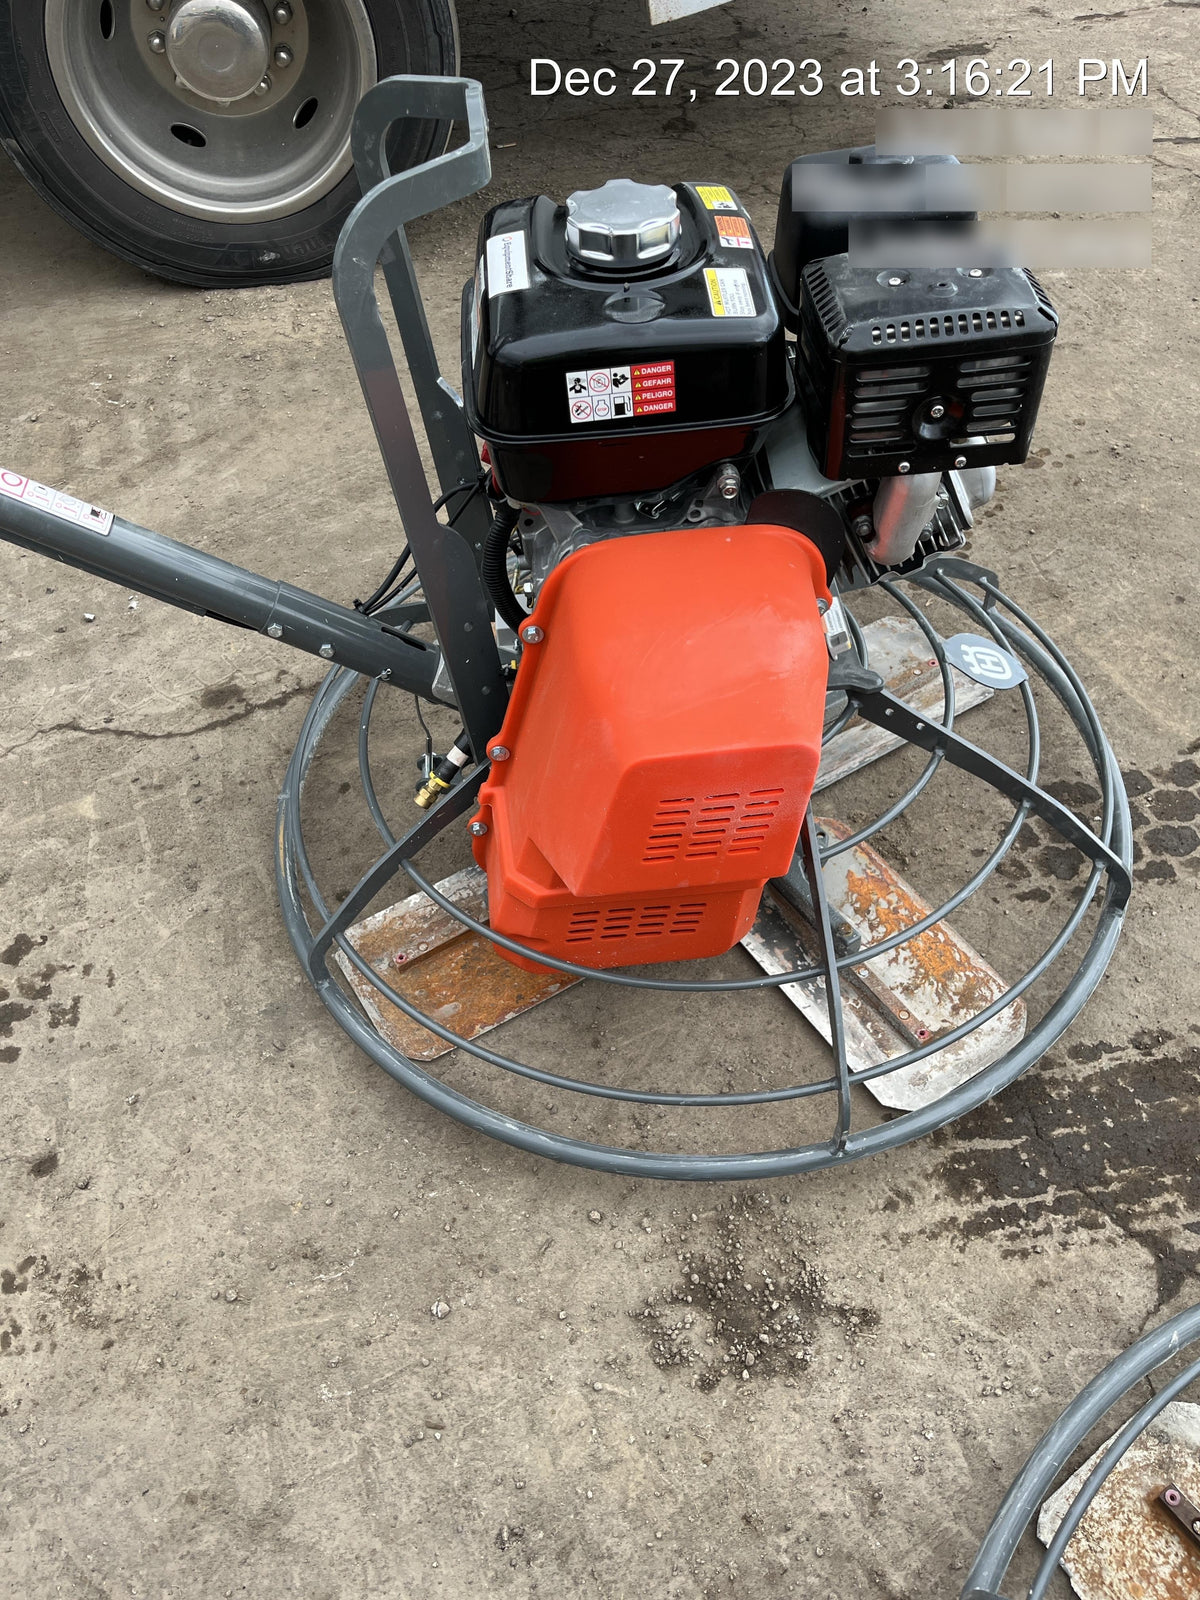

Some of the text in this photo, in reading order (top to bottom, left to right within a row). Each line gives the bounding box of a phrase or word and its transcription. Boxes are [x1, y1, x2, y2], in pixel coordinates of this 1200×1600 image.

[502, 241, 514, 288] EquipmentShare
[709, 278, 720, 299] CAUTION
[641, 365, 672, 374] DANGER
[642, 378, 672, 387] GEFAHR
[642, 390, 673, 399] PELIGRO
[643, 402, 673, 412] DANGER
